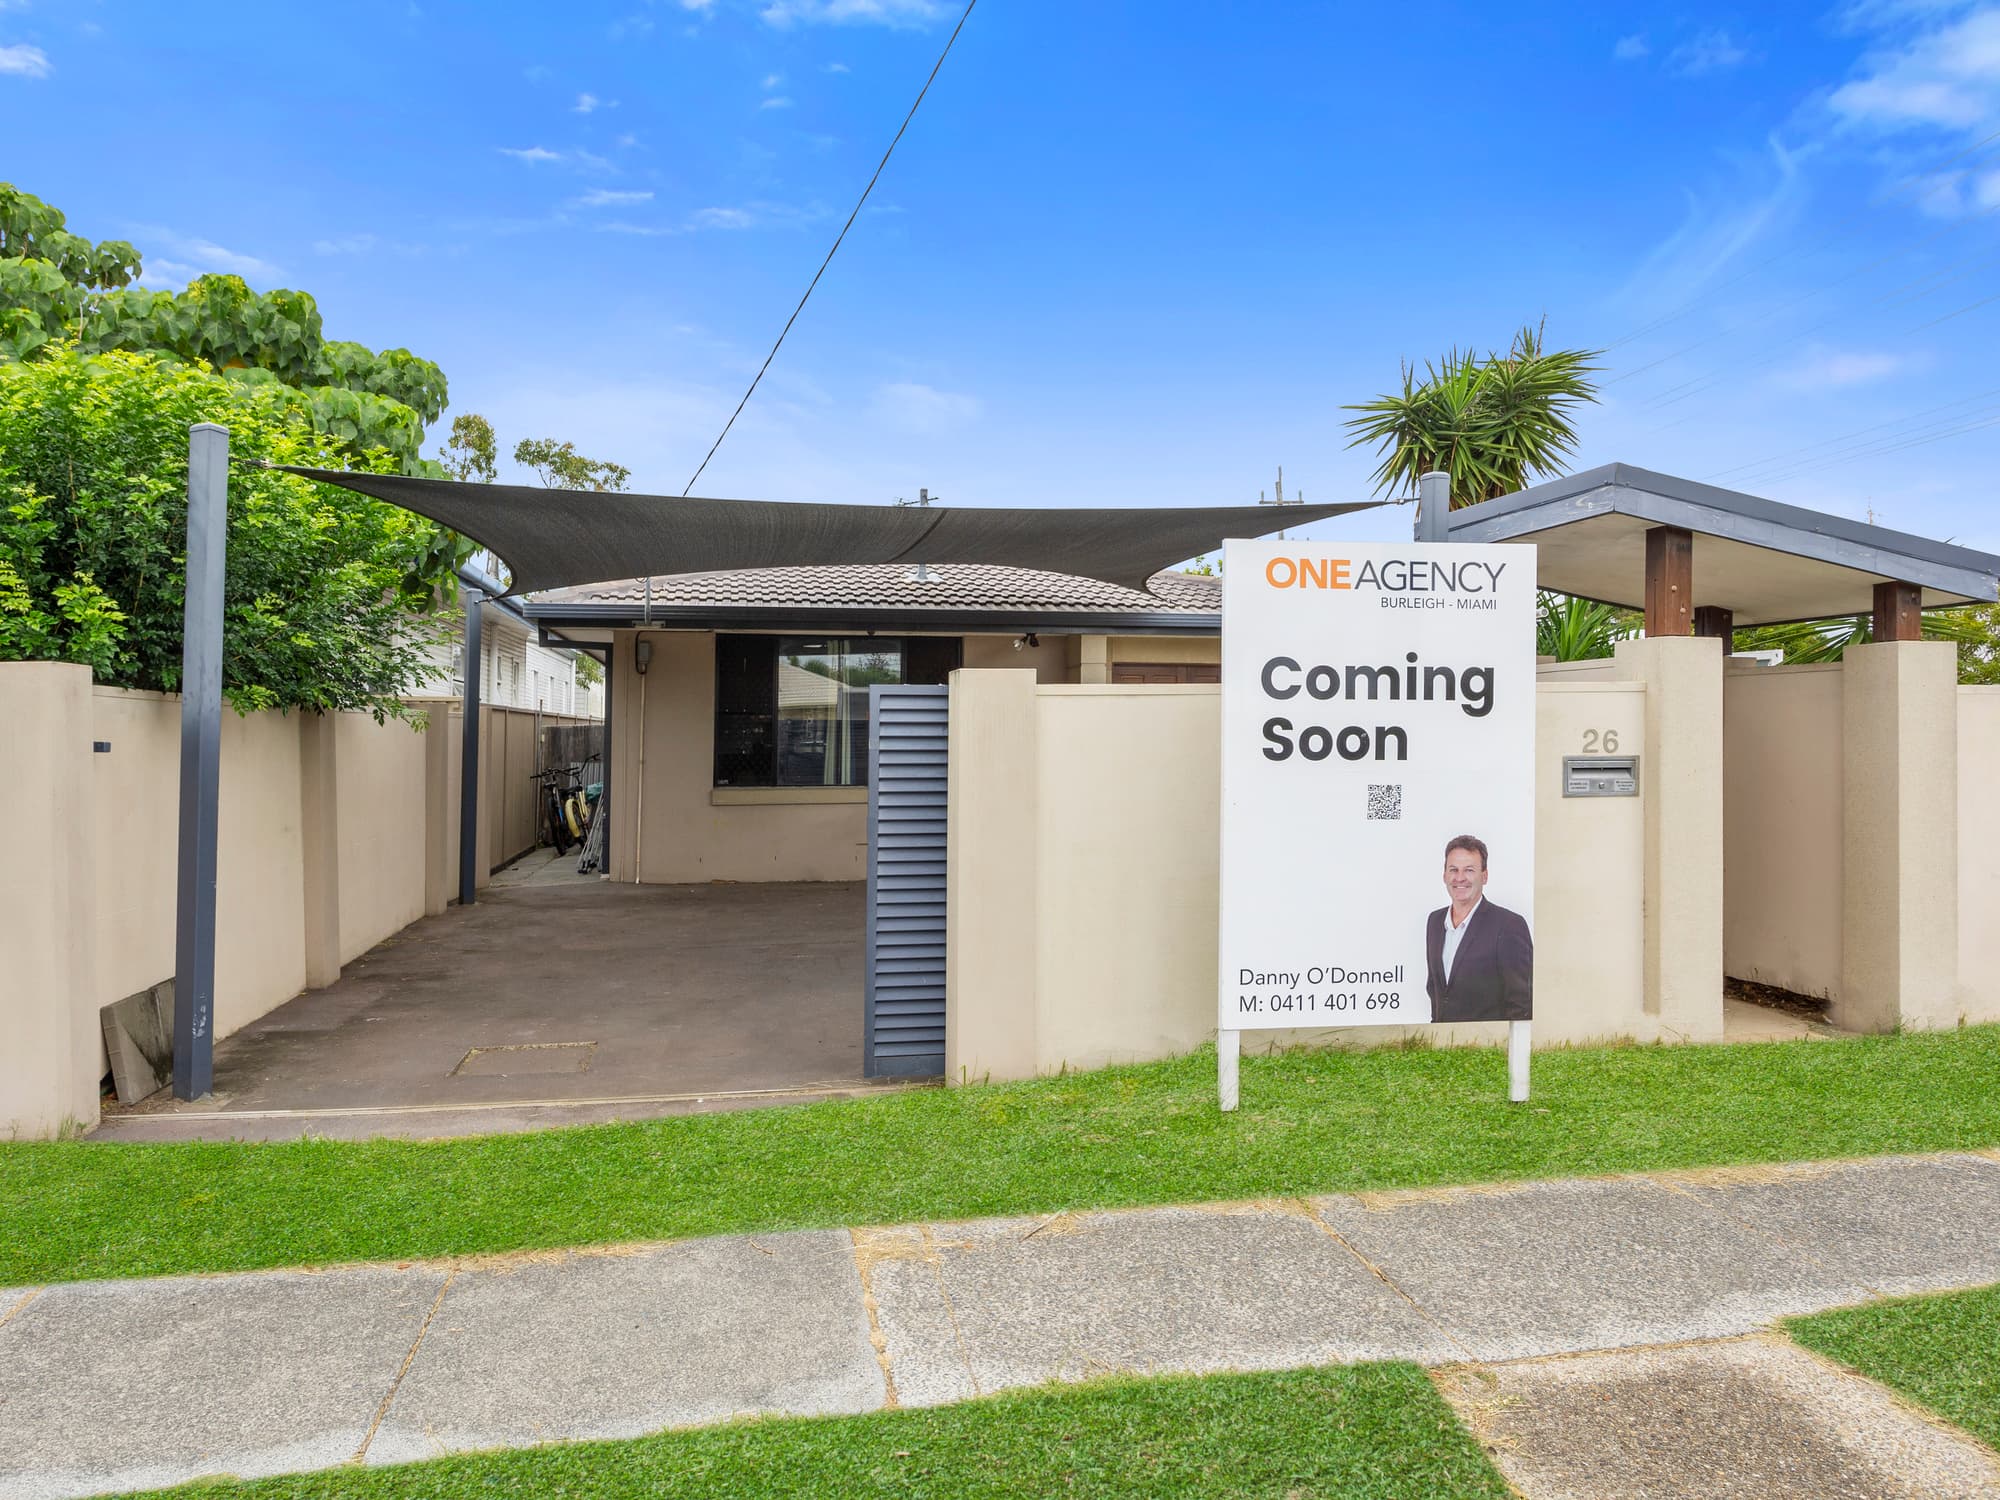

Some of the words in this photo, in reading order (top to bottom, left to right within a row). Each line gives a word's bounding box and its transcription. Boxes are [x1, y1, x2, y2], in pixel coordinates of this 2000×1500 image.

[1380, 597, 1445, 609] BURLEIGH
[1457, 599, 1497, 610] MIAMI
[1261, 652, 1495, 718] Coming
[1262, 717, 1408, 762] Soon
[1582, 729, 1619, 754] 26
[1239, 969, 1301, 990] Danny
[1307, 965, 1404, 985] O'Donnell
[1239, 995, 1263, 1012] M:
[1270, 994, 1315, 1012] 0411
[1324, 993, 1357, 1011] 401
[1366, 992, 1400, 1010] 698
